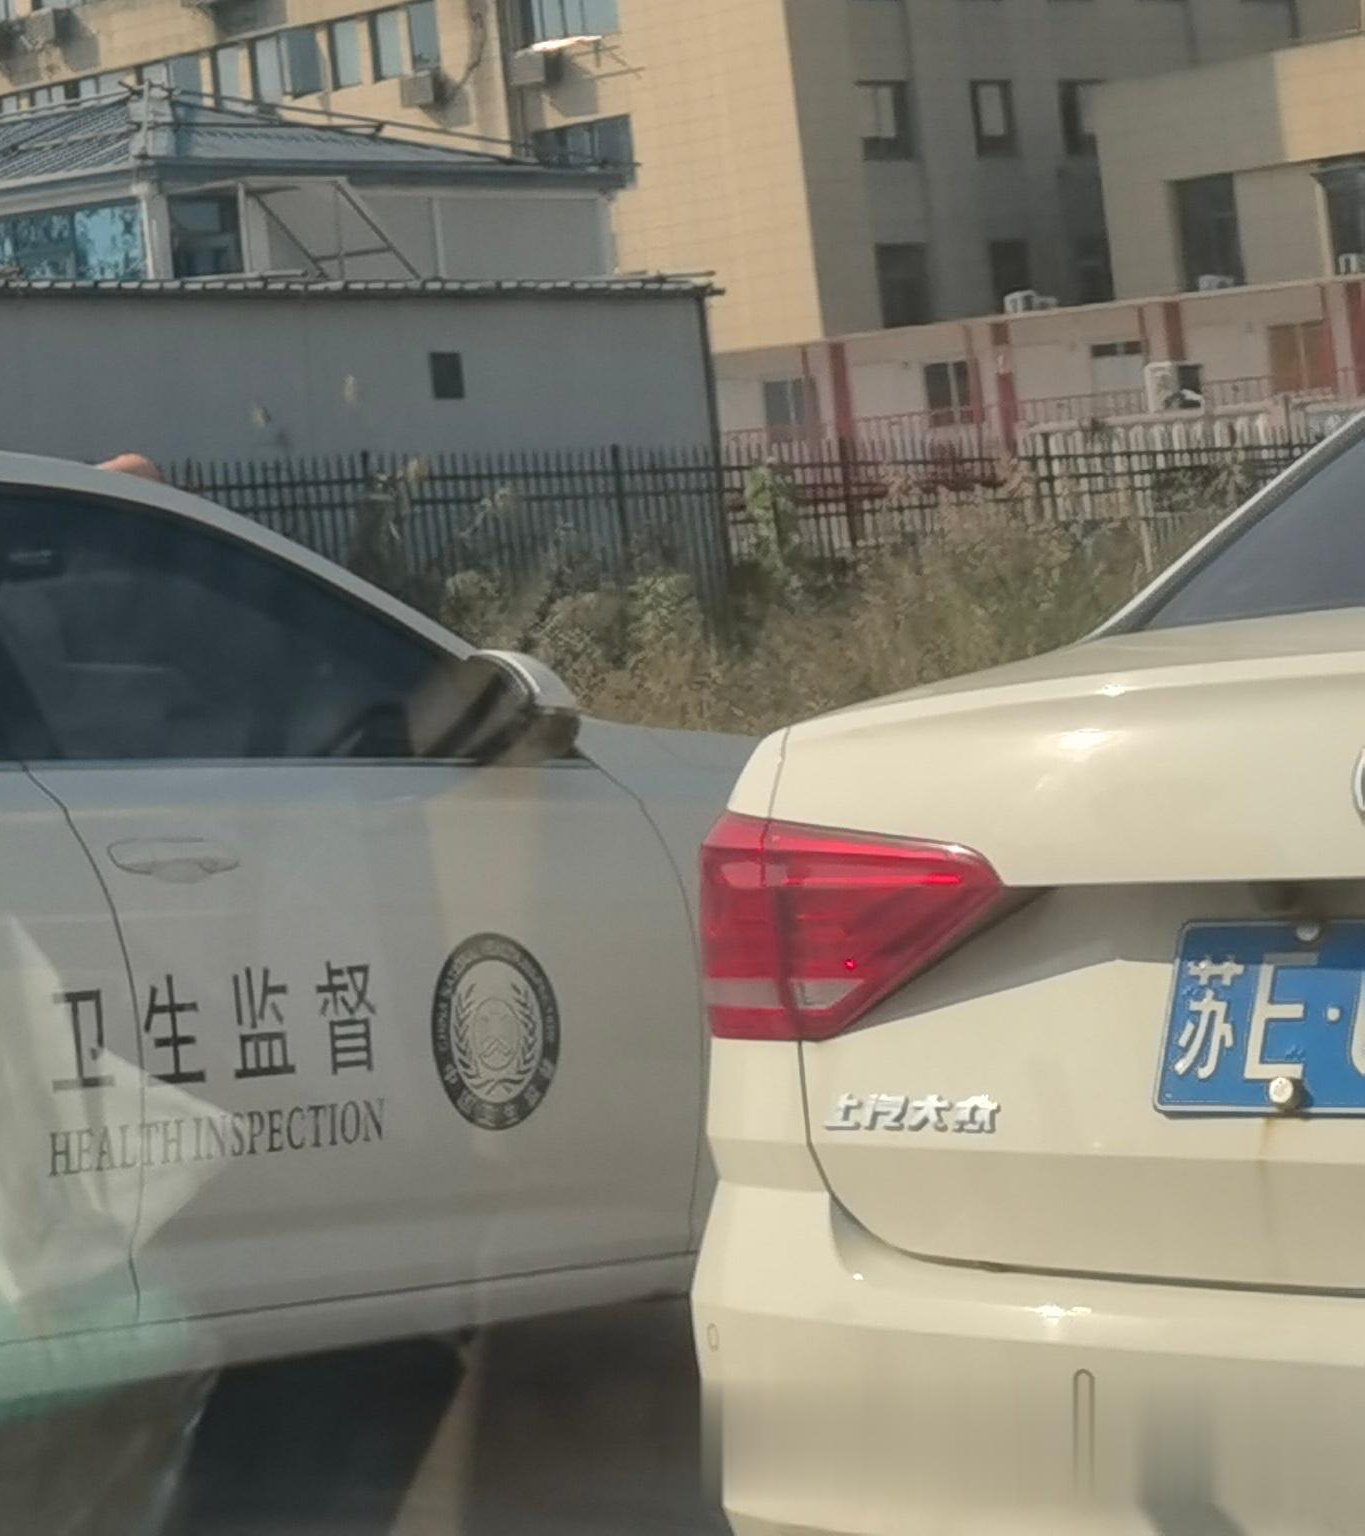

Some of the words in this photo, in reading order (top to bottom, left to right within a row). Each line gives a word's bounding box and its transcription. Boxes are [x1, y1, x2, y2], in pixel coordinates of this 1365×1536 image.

[52, 960, 377, 1093] 卫生监督
[48, 1118, 185, 1177] HEALTH
[193, 1097, 386, 1162] INSPECTION
